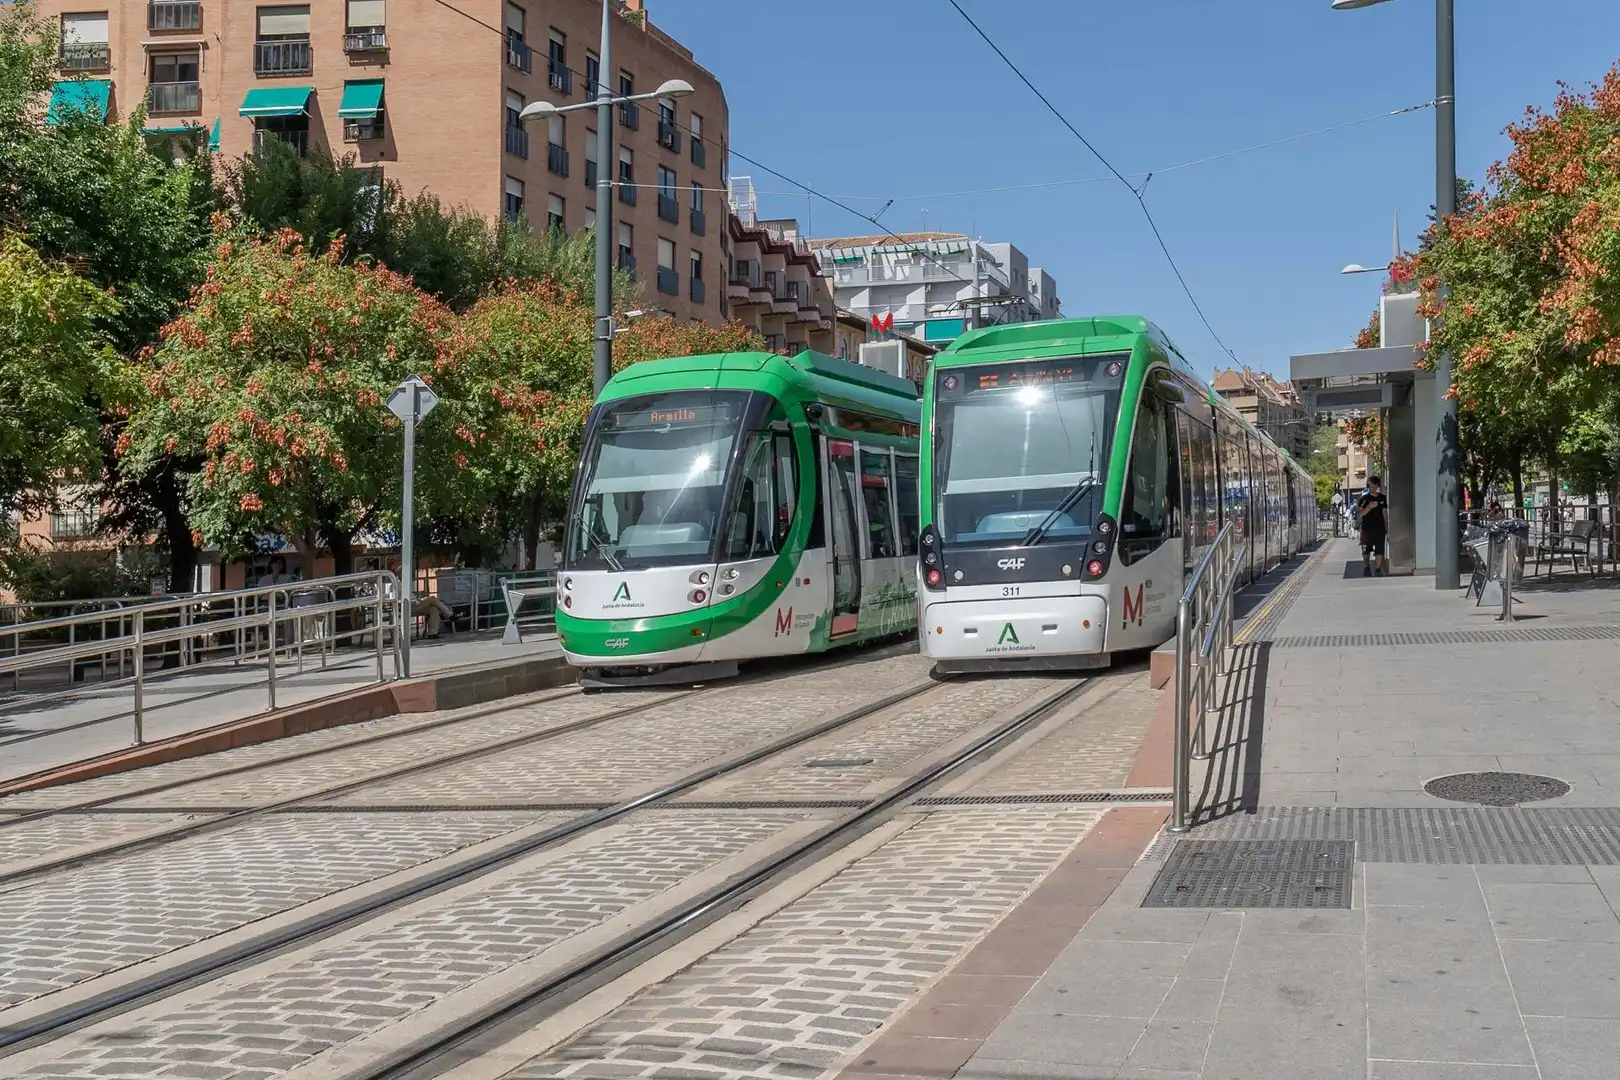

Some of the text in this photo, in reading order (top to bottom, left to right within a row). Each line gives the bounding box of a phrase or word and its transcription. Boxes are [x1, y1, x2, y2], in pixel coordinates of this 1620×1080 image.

[872, 312, 893, 335] M
[650, 408, 696, 422] Armilla
[997, 558, 1026, 570] CAF
[1002, 586, 1020, 596] 311
[1122, 583, 1144, 630] M
[775, 606, 793, 637] M
[604, 637, 630, 649] CAF
